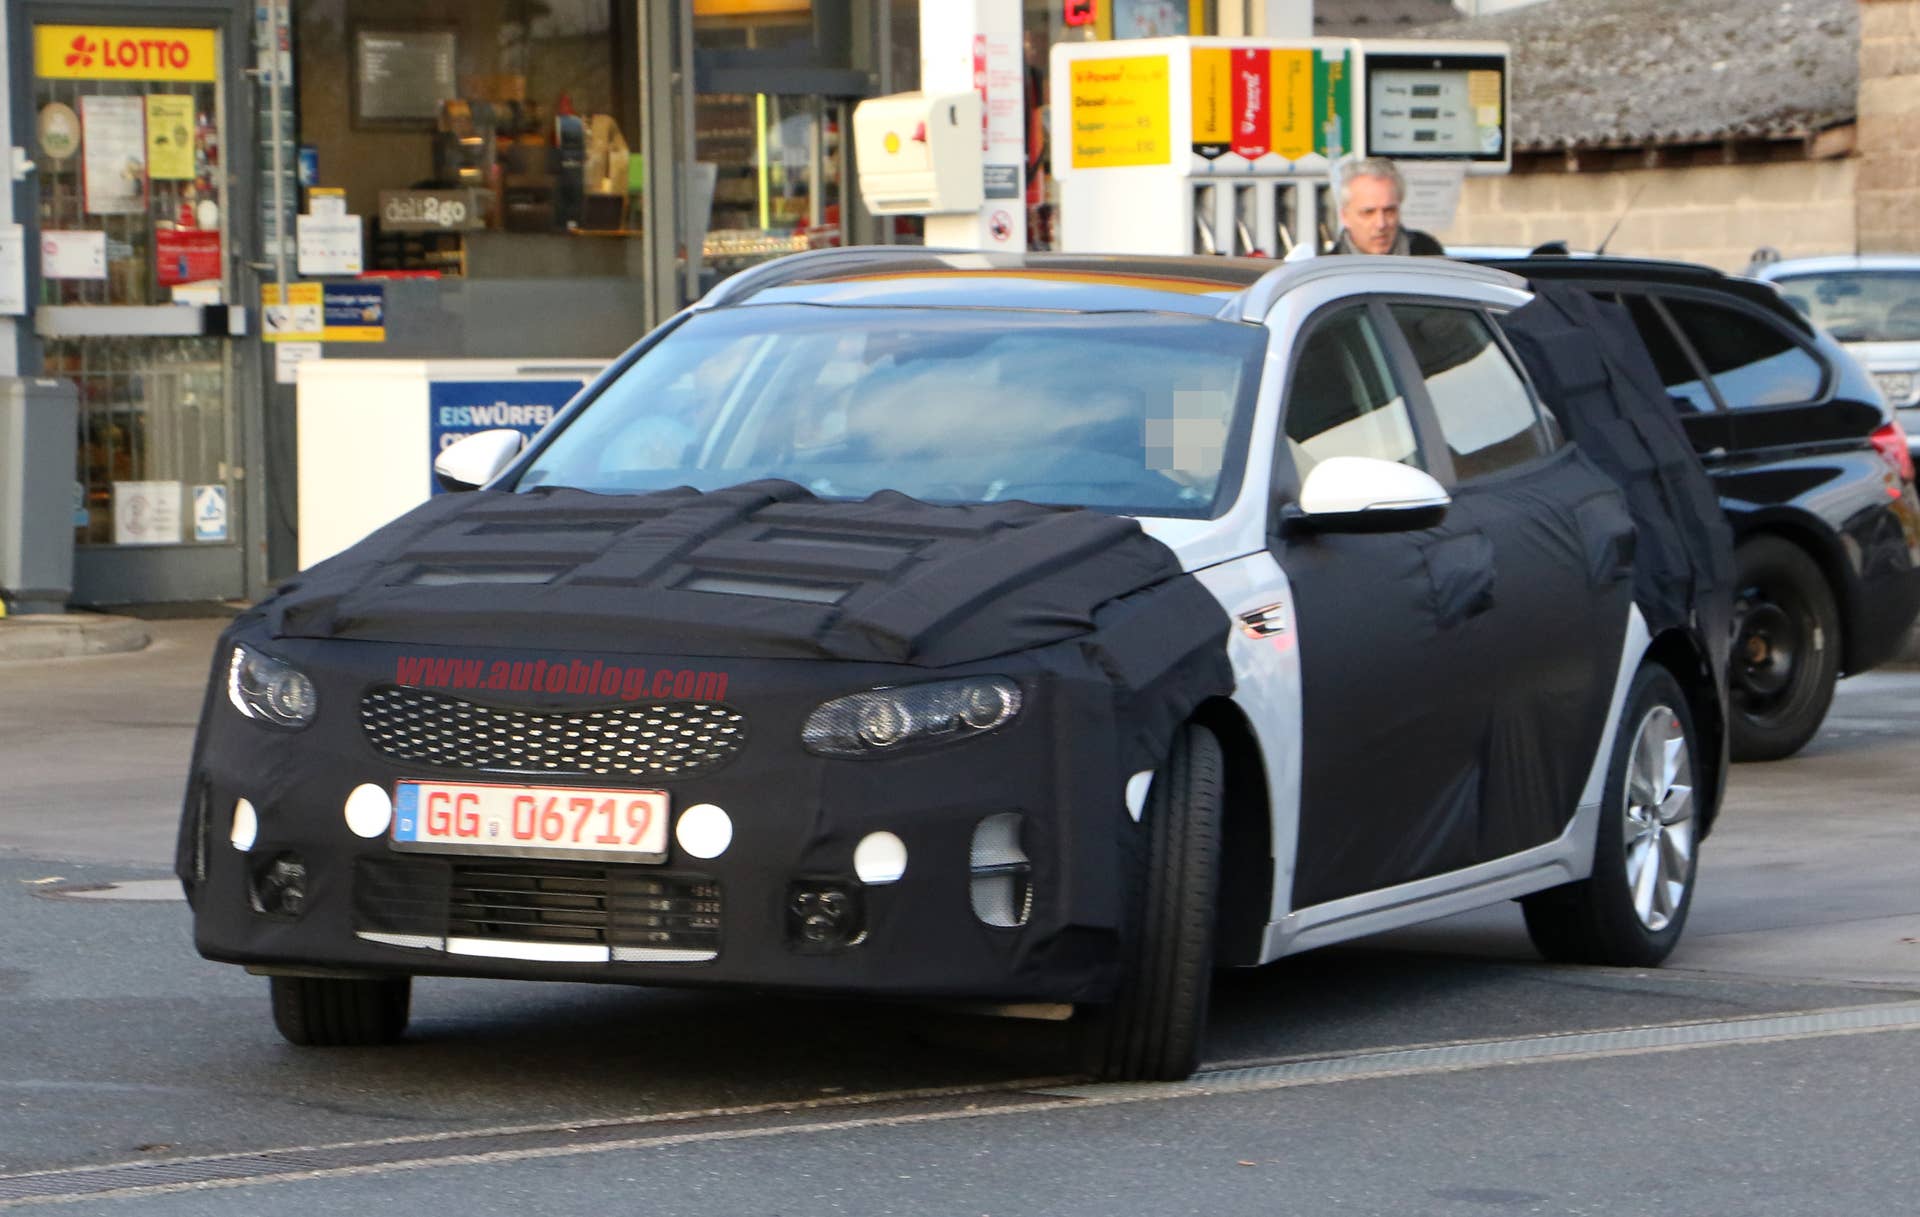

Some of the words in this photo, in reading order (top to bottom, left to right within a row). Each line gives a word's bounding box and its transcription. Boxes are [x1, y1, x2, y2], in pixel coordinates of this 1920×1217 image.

[103, 39, 190, 68] LOTTO
[385, 196, 467, 226] deli2go
[426, 791, 480, 838] GG
[511, 795, 653, 845] 06719
